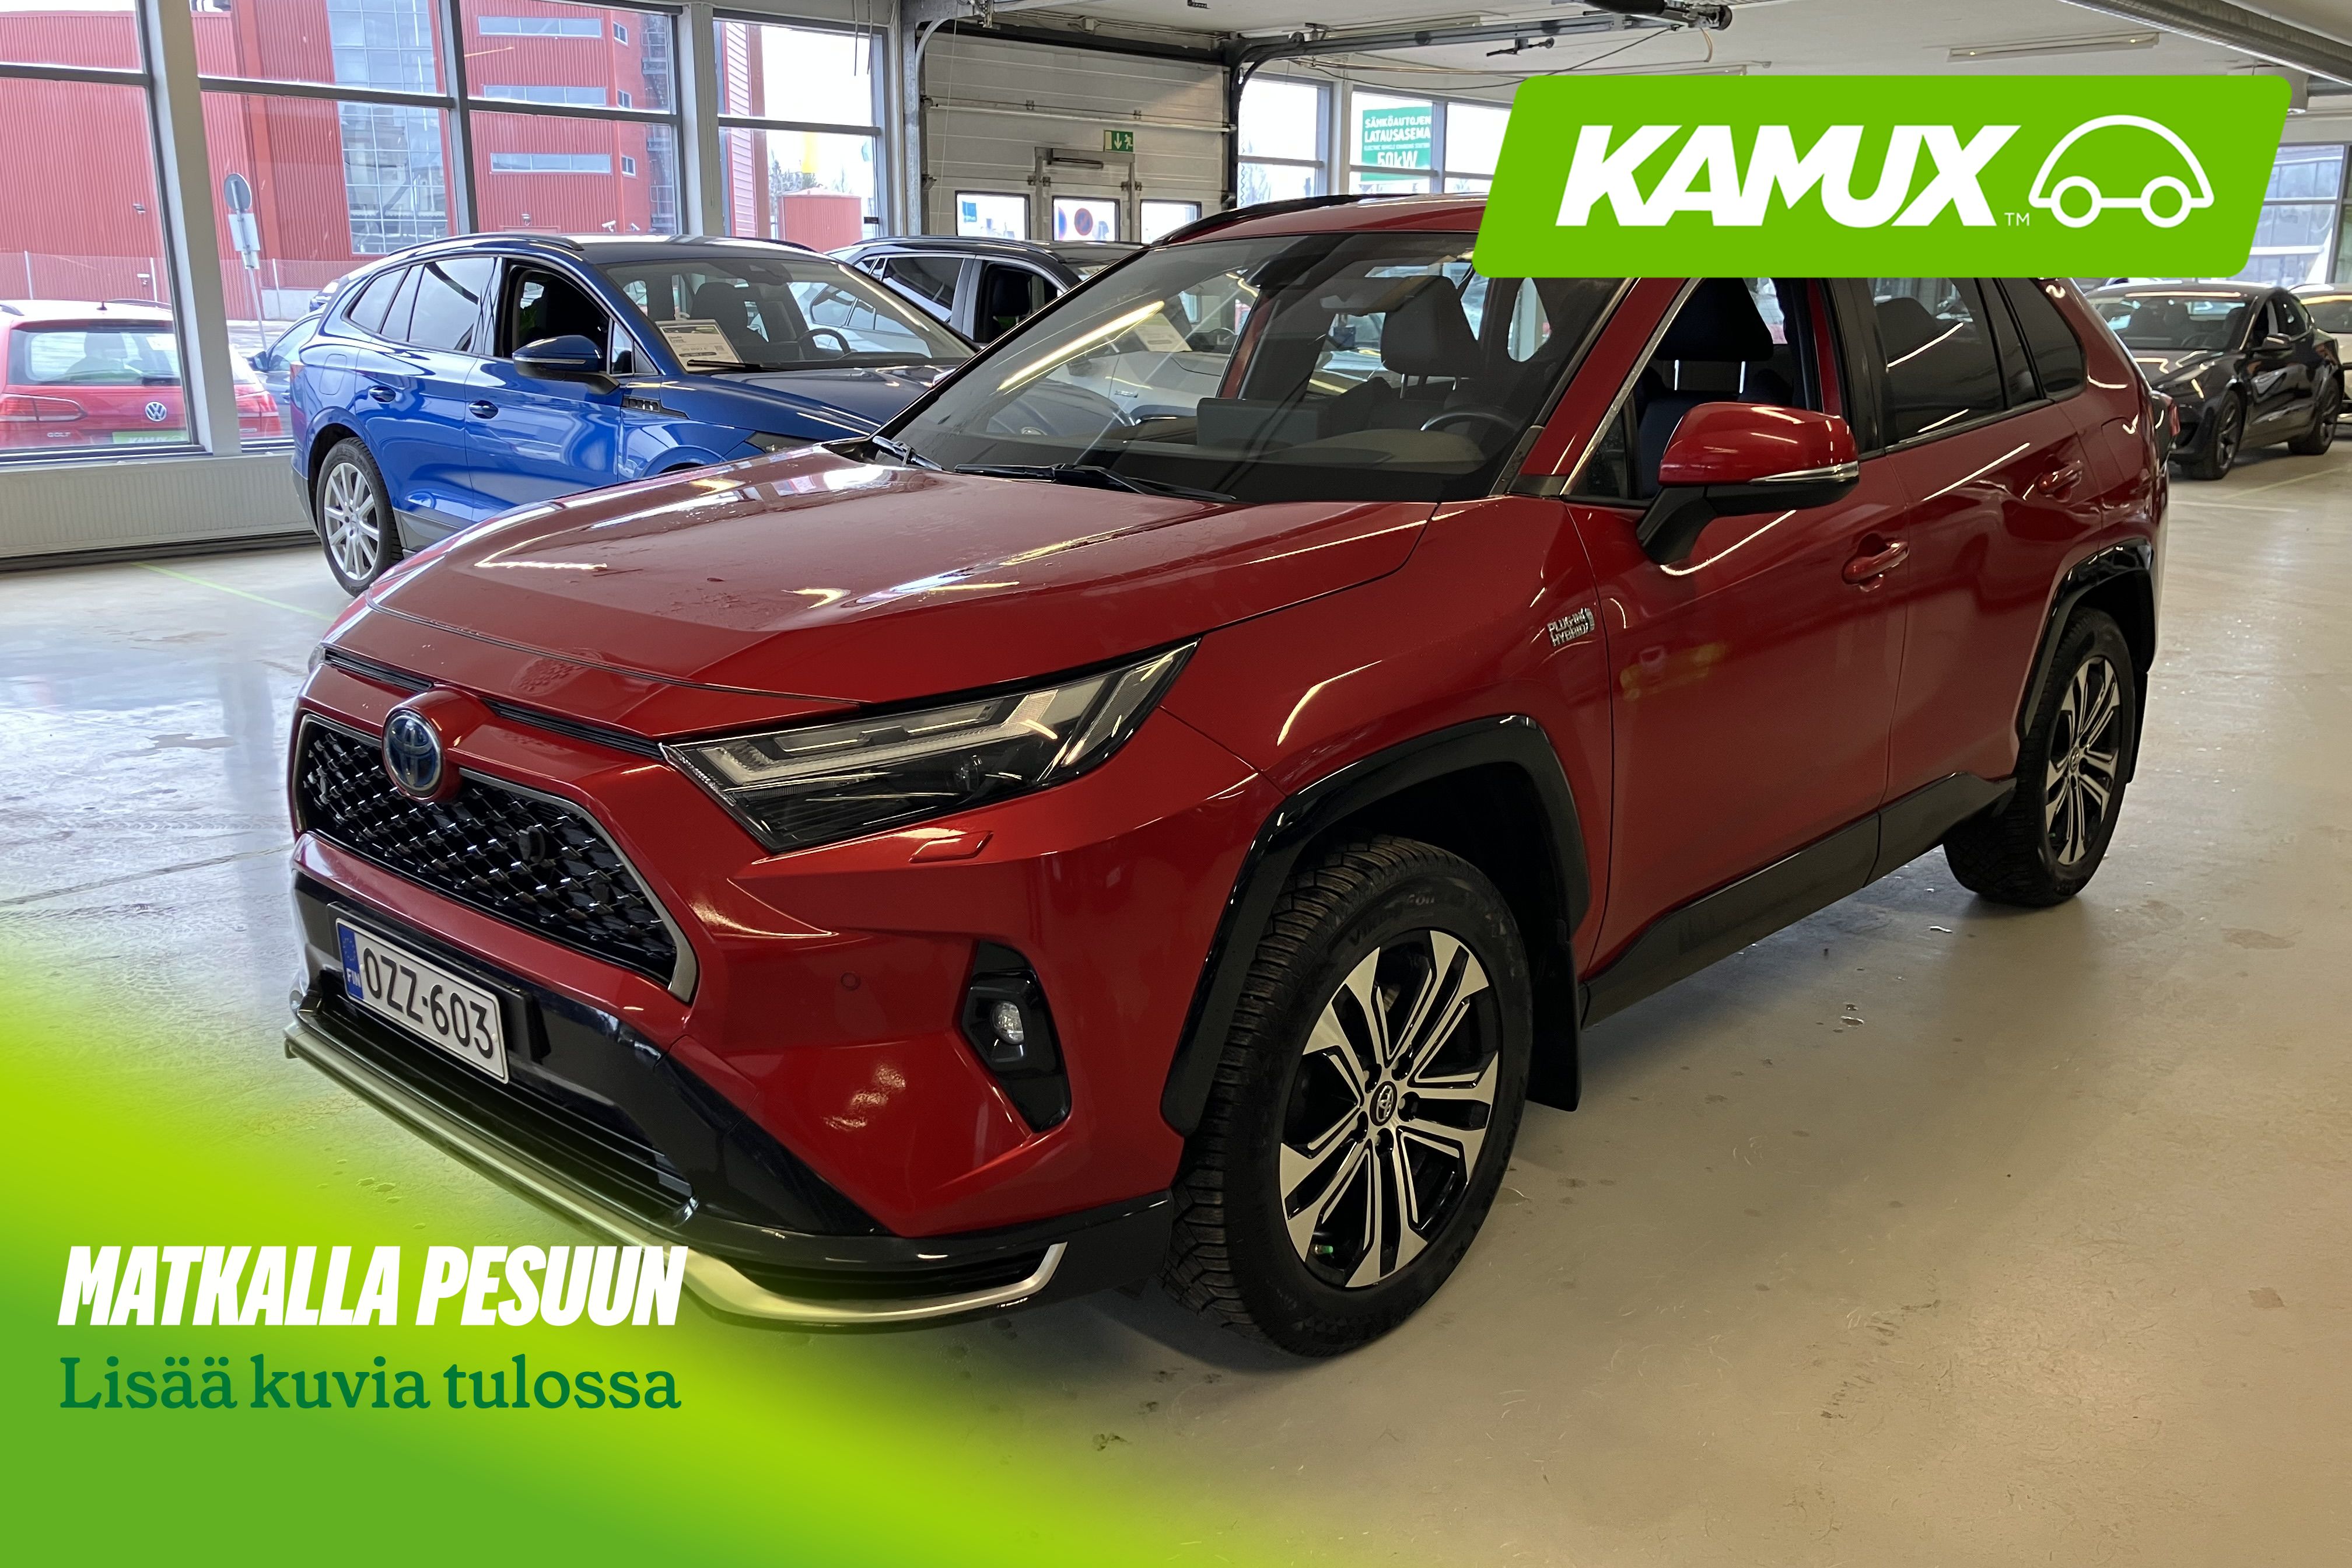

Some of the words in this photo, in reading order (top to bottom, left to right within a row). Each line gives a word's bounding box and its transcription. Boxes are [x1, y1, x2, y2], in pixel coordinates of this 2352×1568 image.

[1365, 115, 1432, 128] SÄHKÖAUTOJEN
[1364, 127, 1431, 142] LATAUSASEMA
[1547, 608, 1585, 632] PLUG-IN
[1550, 623, 1588, 647] HYBRID
[346, 968, 362, 988] FIN
[363, 947, 494, 1059] OZZ-603
